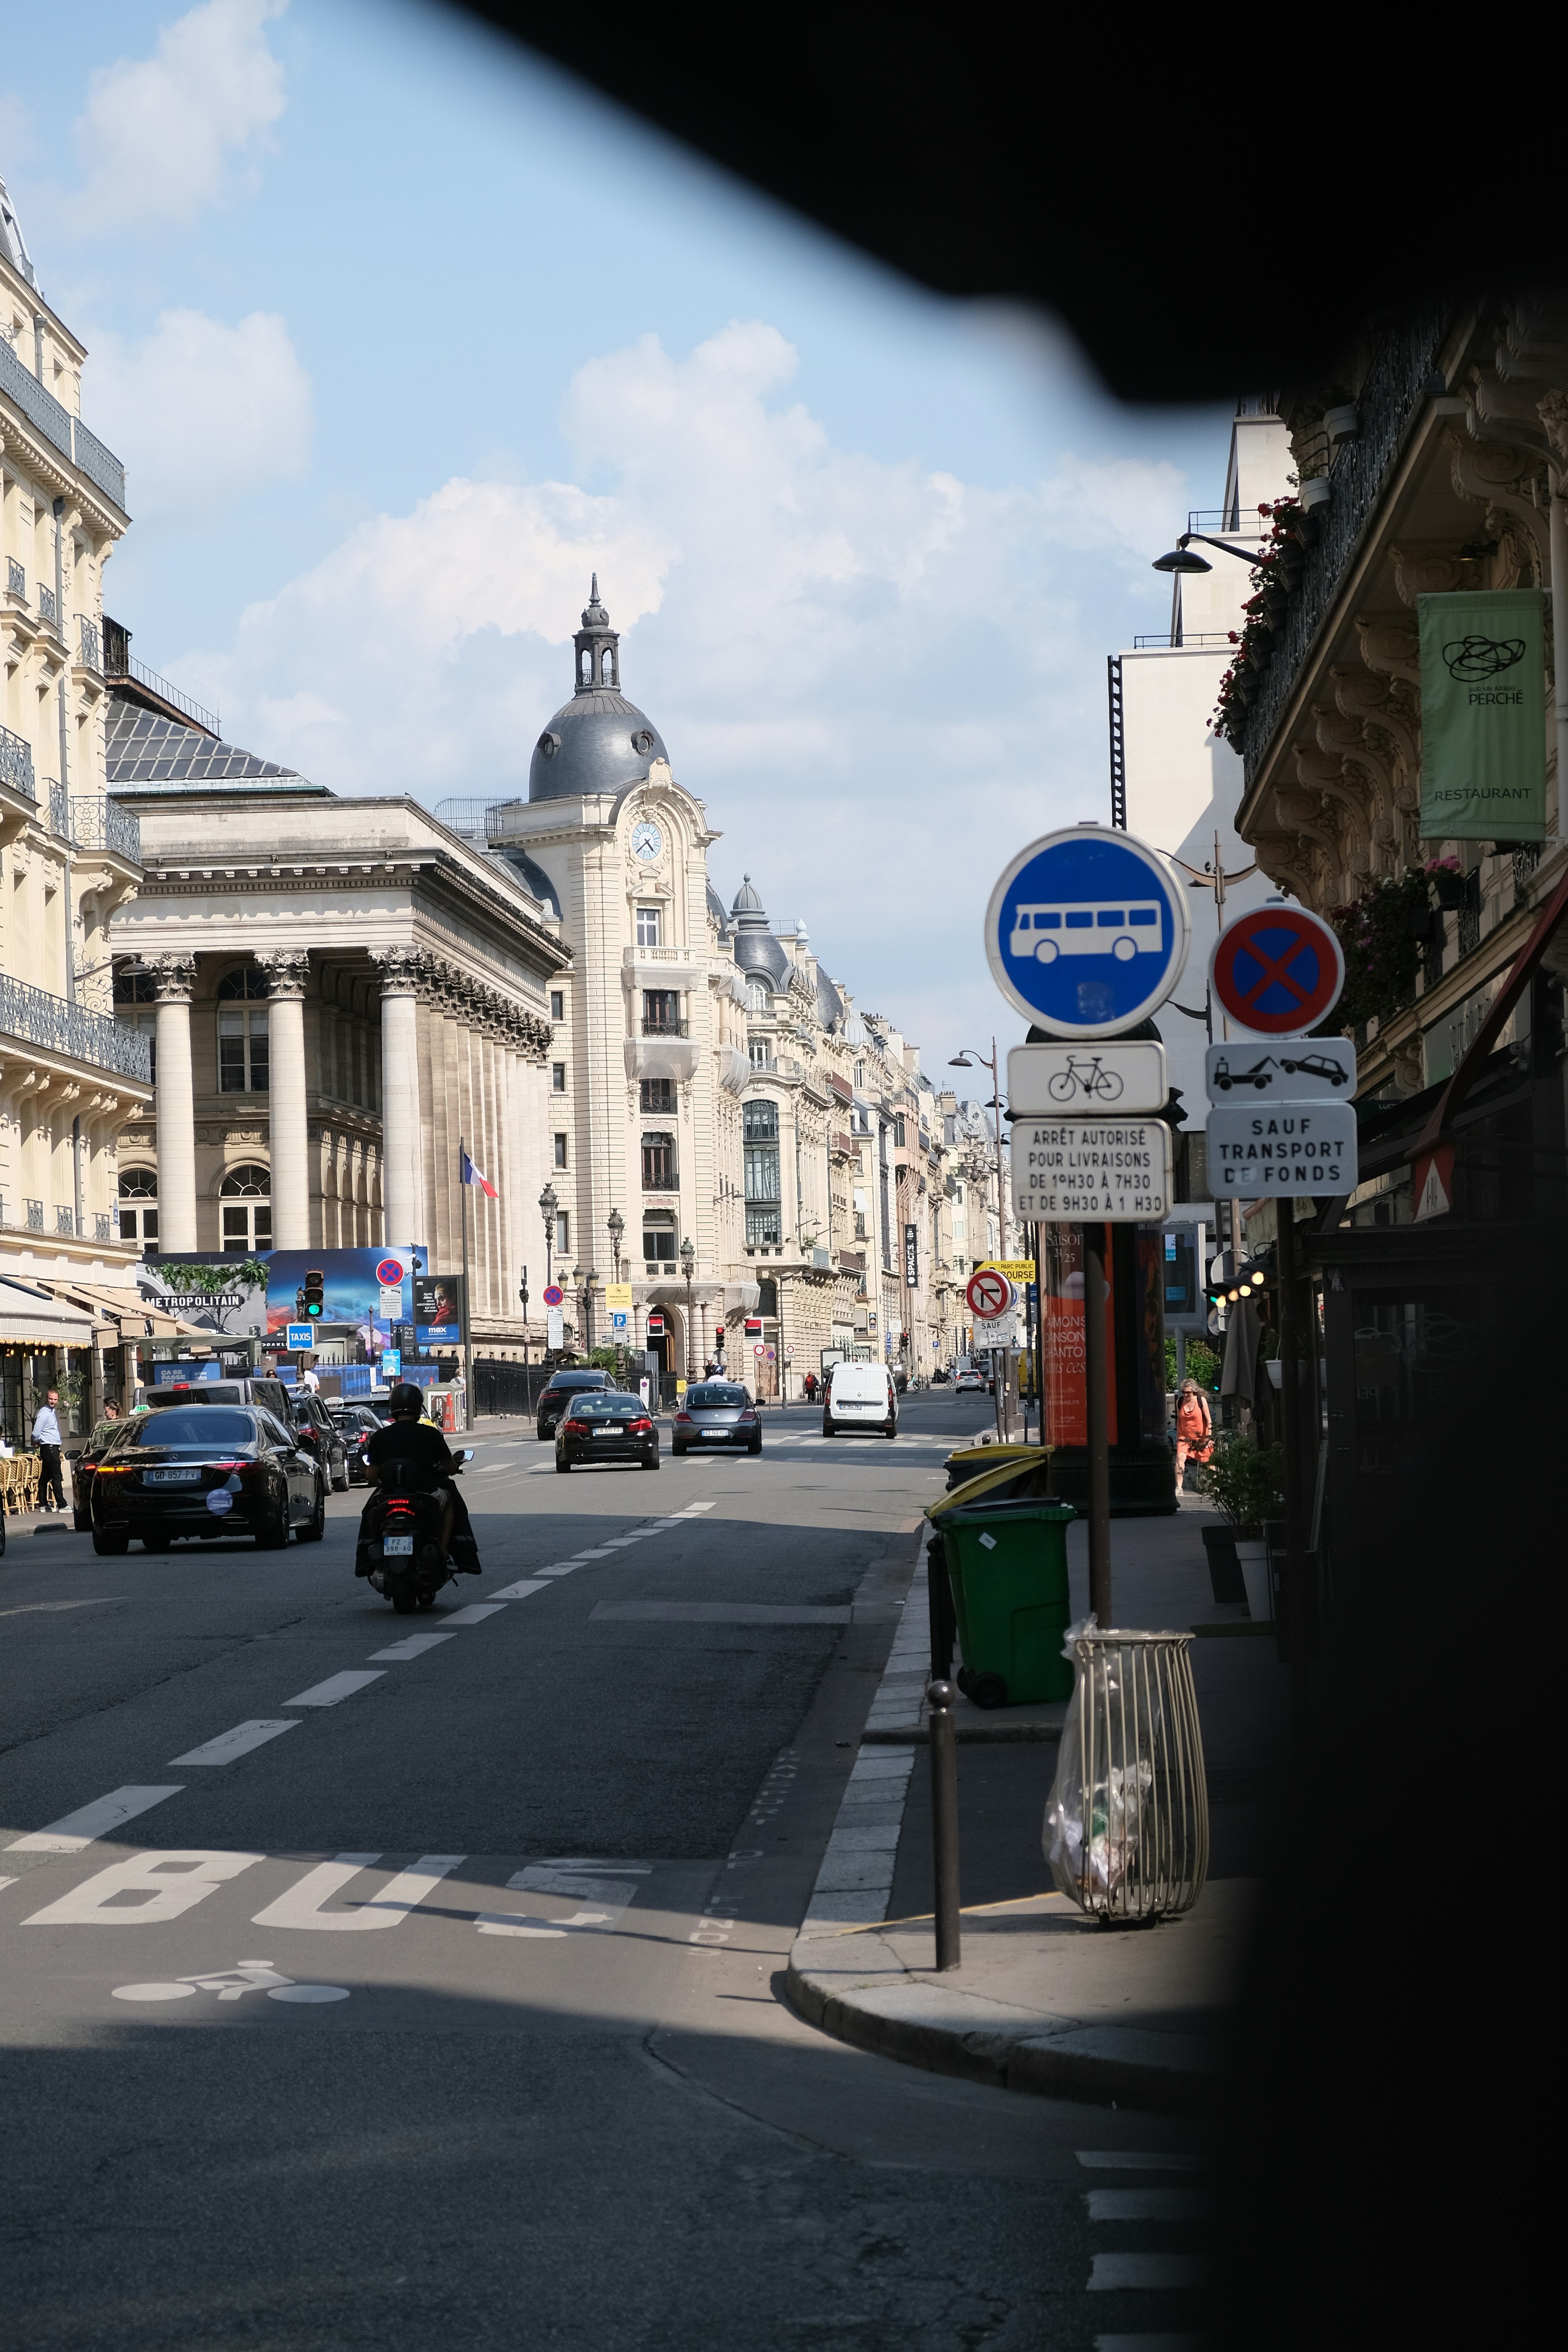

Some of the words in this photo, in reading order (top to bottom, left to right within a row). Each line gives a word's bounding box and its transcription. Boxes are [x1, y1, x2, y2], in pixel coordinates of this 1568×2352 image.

[1469, 689, 1523, 705] PERCHÉ
[1435, 788, 1532, 801] RESTAURANT
[1252, 1119, 1311, 1135] SAUF
[1034, 1127, 1075, 1145] ARRÊT
[1082, 1128, 1146, 1145] AUTORISÉ
[1220, 1142, 1344, 1159] TRANSPORT
[1029, 1152, 1063, 1167] POUR
[1069, 1152, 1151, 1167] LIVRAISONS
[1030, 1174, 1046, 1188] DE
[1101, 1171, 1109, 1189] À
[1116, 1174, 1150, 1189] 7H30
[1225, 1168, 1251, 1183] DE
[1265, 1165, 1340, 1182] FONDS
[1020, 1196, 1034, 1210] ET
[1040, 1196, 1057, 1210] DE
[1063, 1196, 1098, 1211] 9H30
[1106, 1193, 1113, 1211] À
[146, 1296, 239, 1307] METROPOLITAIN
[290, 1333, 311, 1341] TAXIS
[1045, 1346, 1086, 1358] CHANTO
[155, 1470, 195, 1479] GD-857-PV
[19, 1850, 652, 1939] BUS
